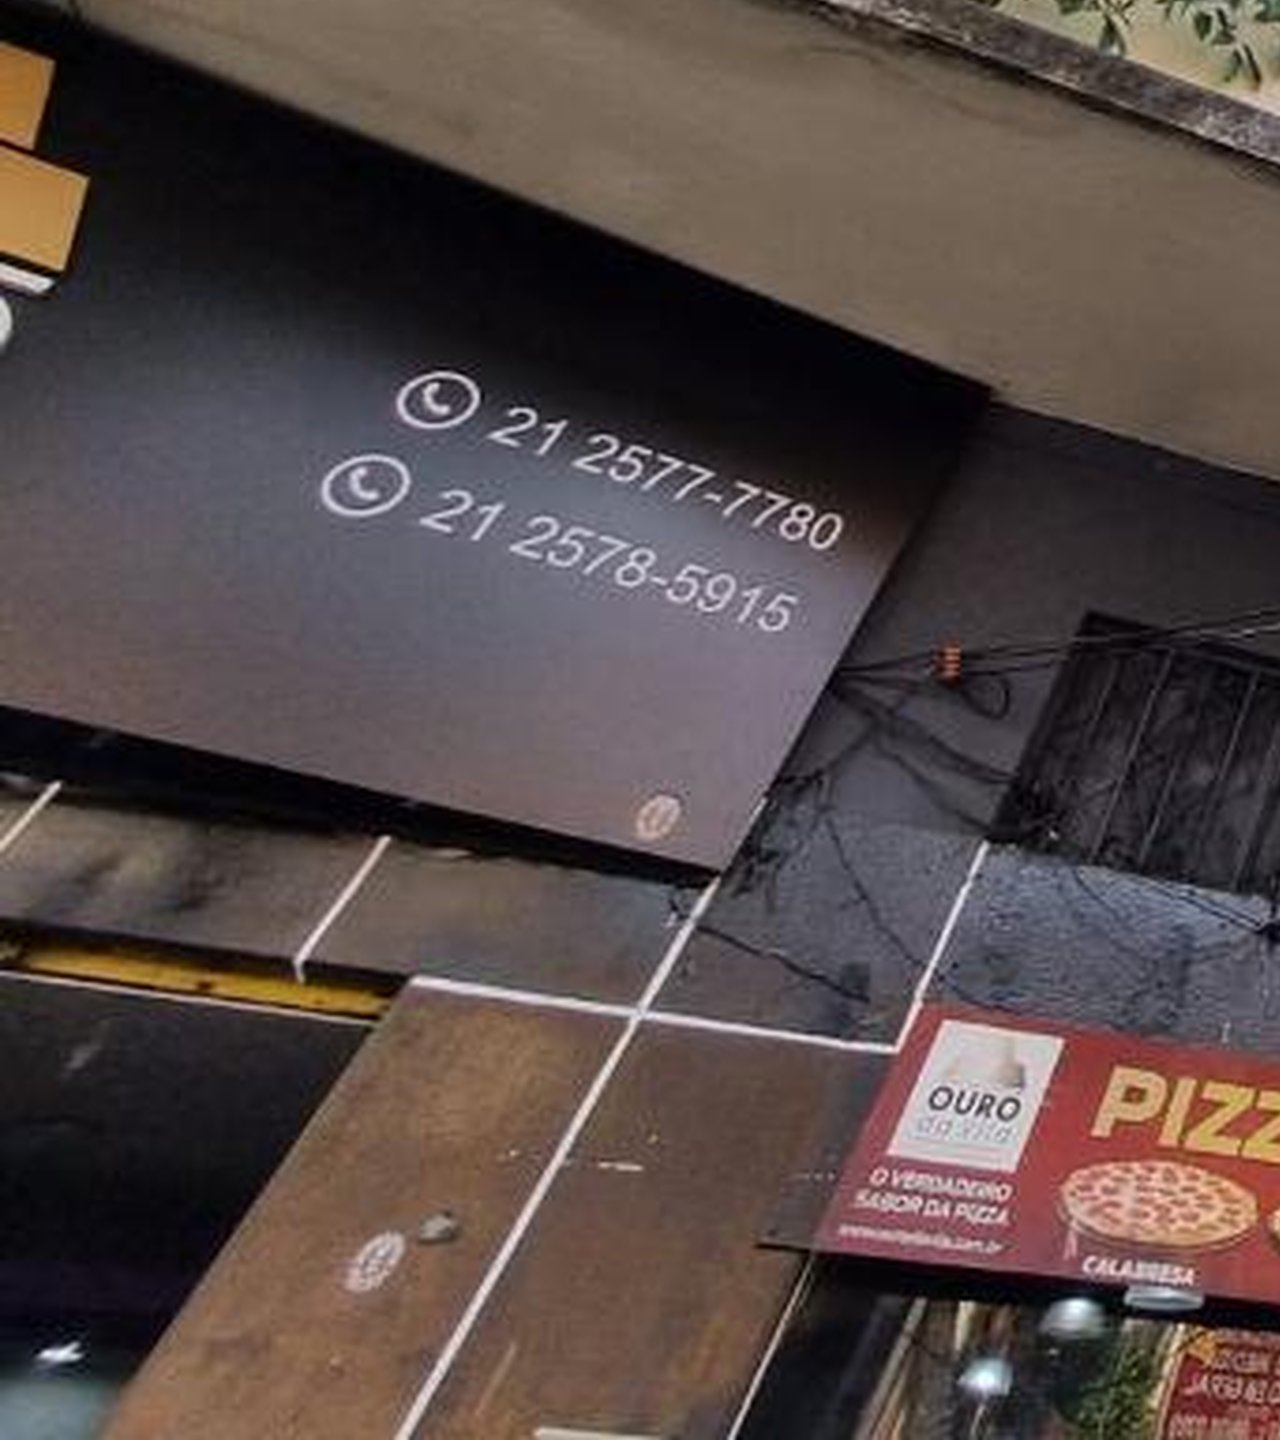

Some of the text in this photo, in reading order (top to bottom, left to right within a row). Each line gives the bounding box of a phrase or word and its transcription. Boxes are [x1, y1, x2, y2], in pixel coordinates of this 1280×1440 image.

[487, 407, 844, 550] 21 2577-7780
[419, 489, 798, 633] 21 2578-5915
[928, 1085, 1022, 1122] OURO
[869, 1167, 1013, 1203] O VERDADEIRO
[854, 1188, 1011, 1227] SABOR DA PIZZA
[1081, 1255, 1196, 1287] CALABRESA
